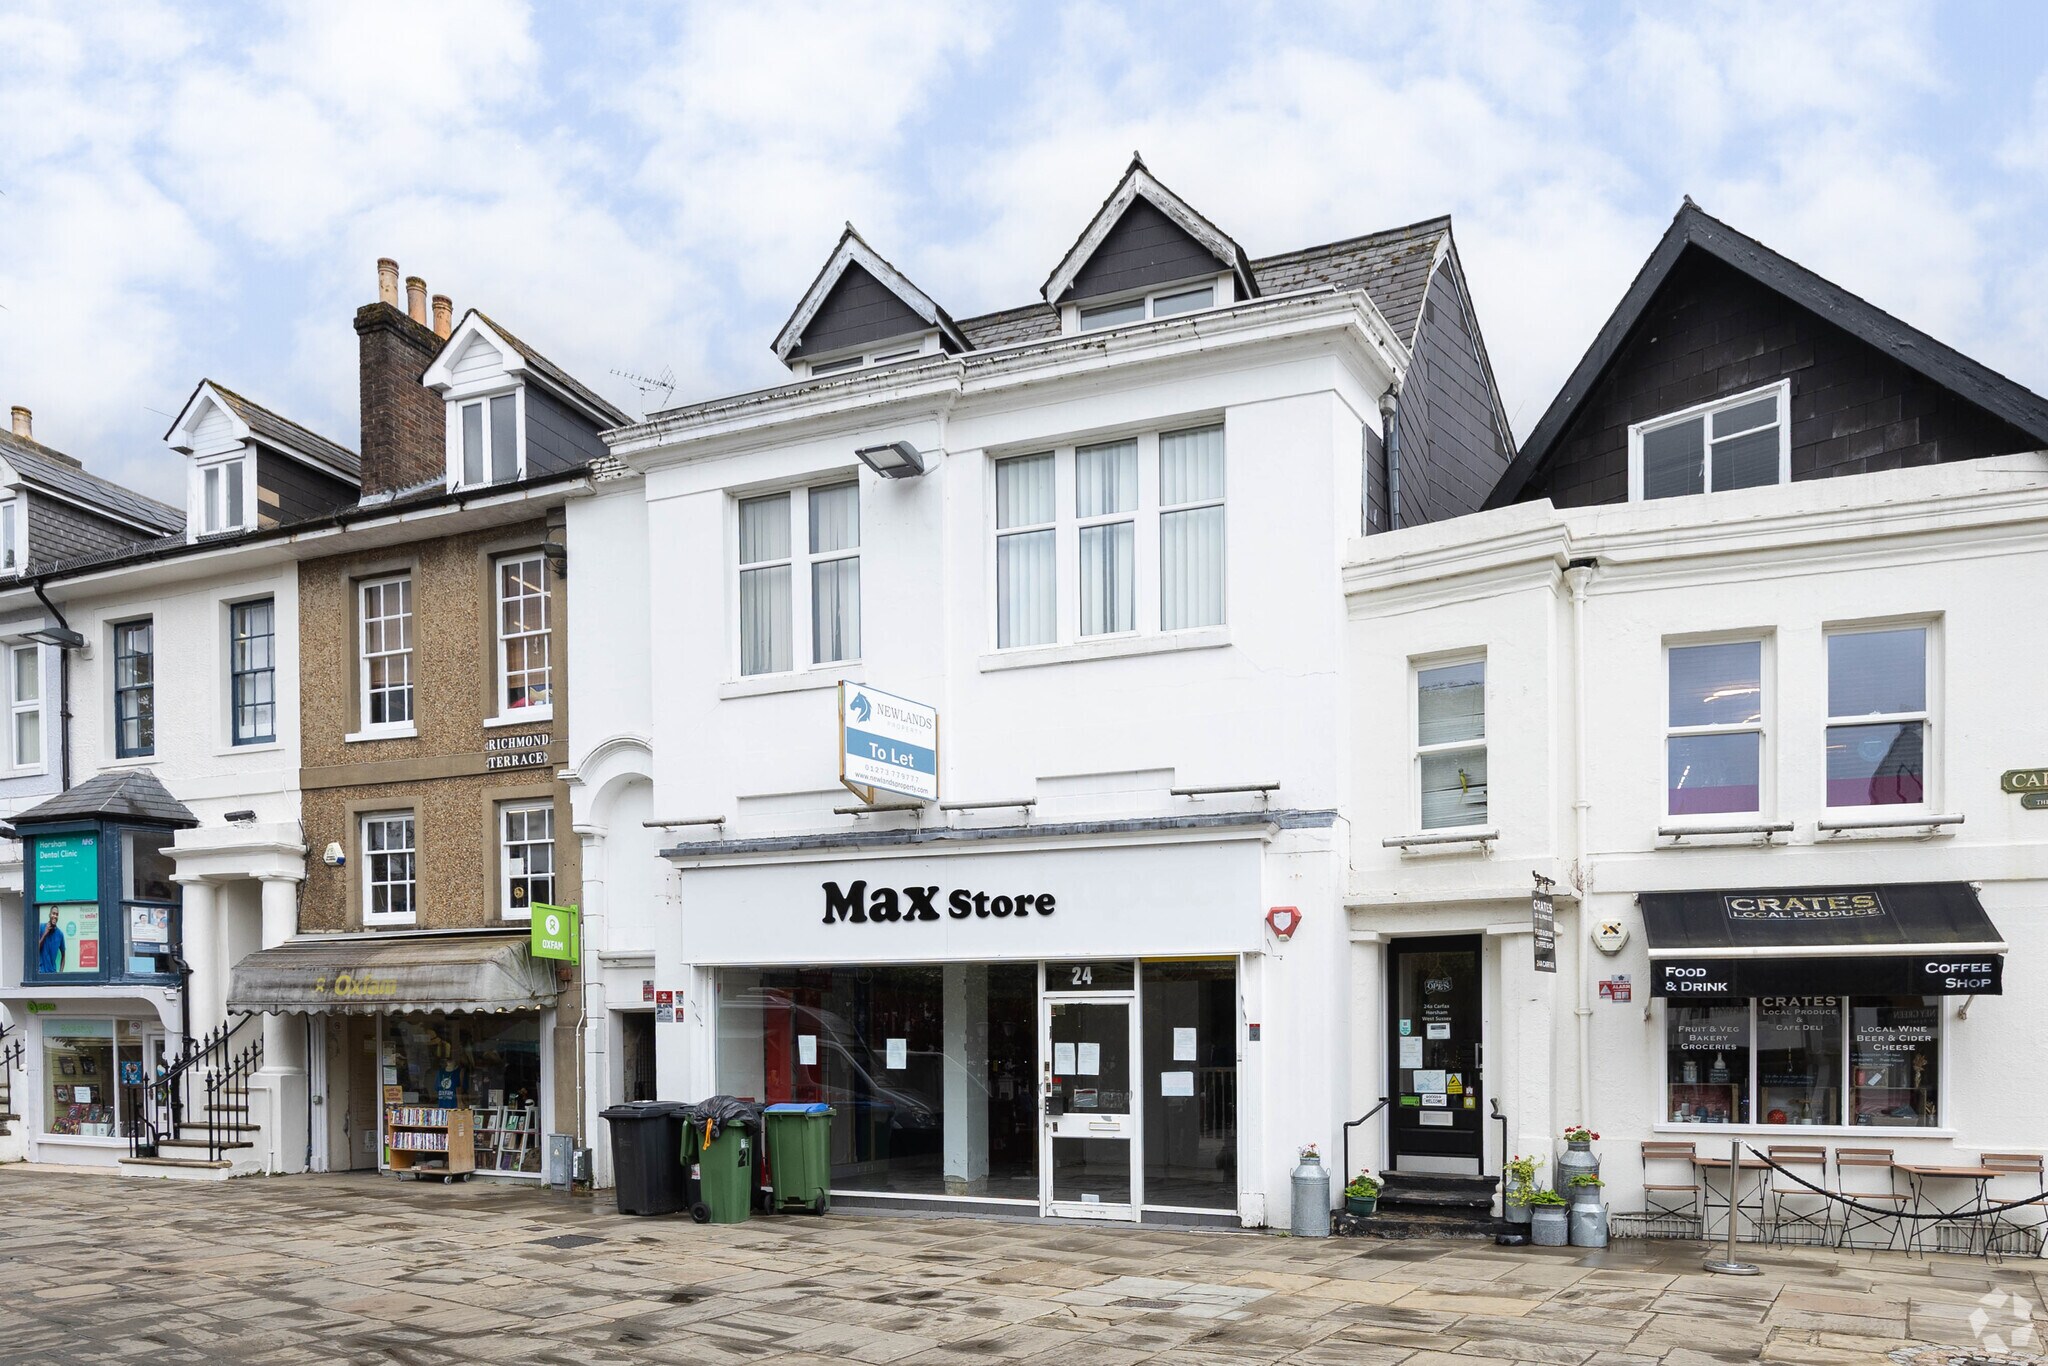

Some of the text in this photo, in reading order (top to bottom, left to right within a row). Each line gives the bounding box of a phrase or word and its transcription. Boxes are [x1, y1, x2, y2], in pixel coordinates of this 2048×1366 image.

[876, 704, 932, 730] NEWLANDS
[488, 734, 548, 750] RICHMOND
[488, 752, 543, 768] TERRACE
[869, 742, 914, 767] To Let
[855, 772, 928, 794] www.newlandsproperty.com
[40, 840, 66, 848] Horsham
[60, 850, 78, 858] Clinic
[822, 880, 1056, 924] Max Store
[1533, 900, 1553, 914] CRATES
[1730, 894, 1876, 911] CRATES
[1793, 908, 1880, 919] PRODUCE
[542, 940, 564, 950] OXFAM
[1072, 966, 1092, 985] 24
[334, 972, 397, 996] Oxfam
[1665, 982, 1677, 991] &
[1762, 996, 1836, 1007] CRATES
[738, 1149, 749, 1167] 21
